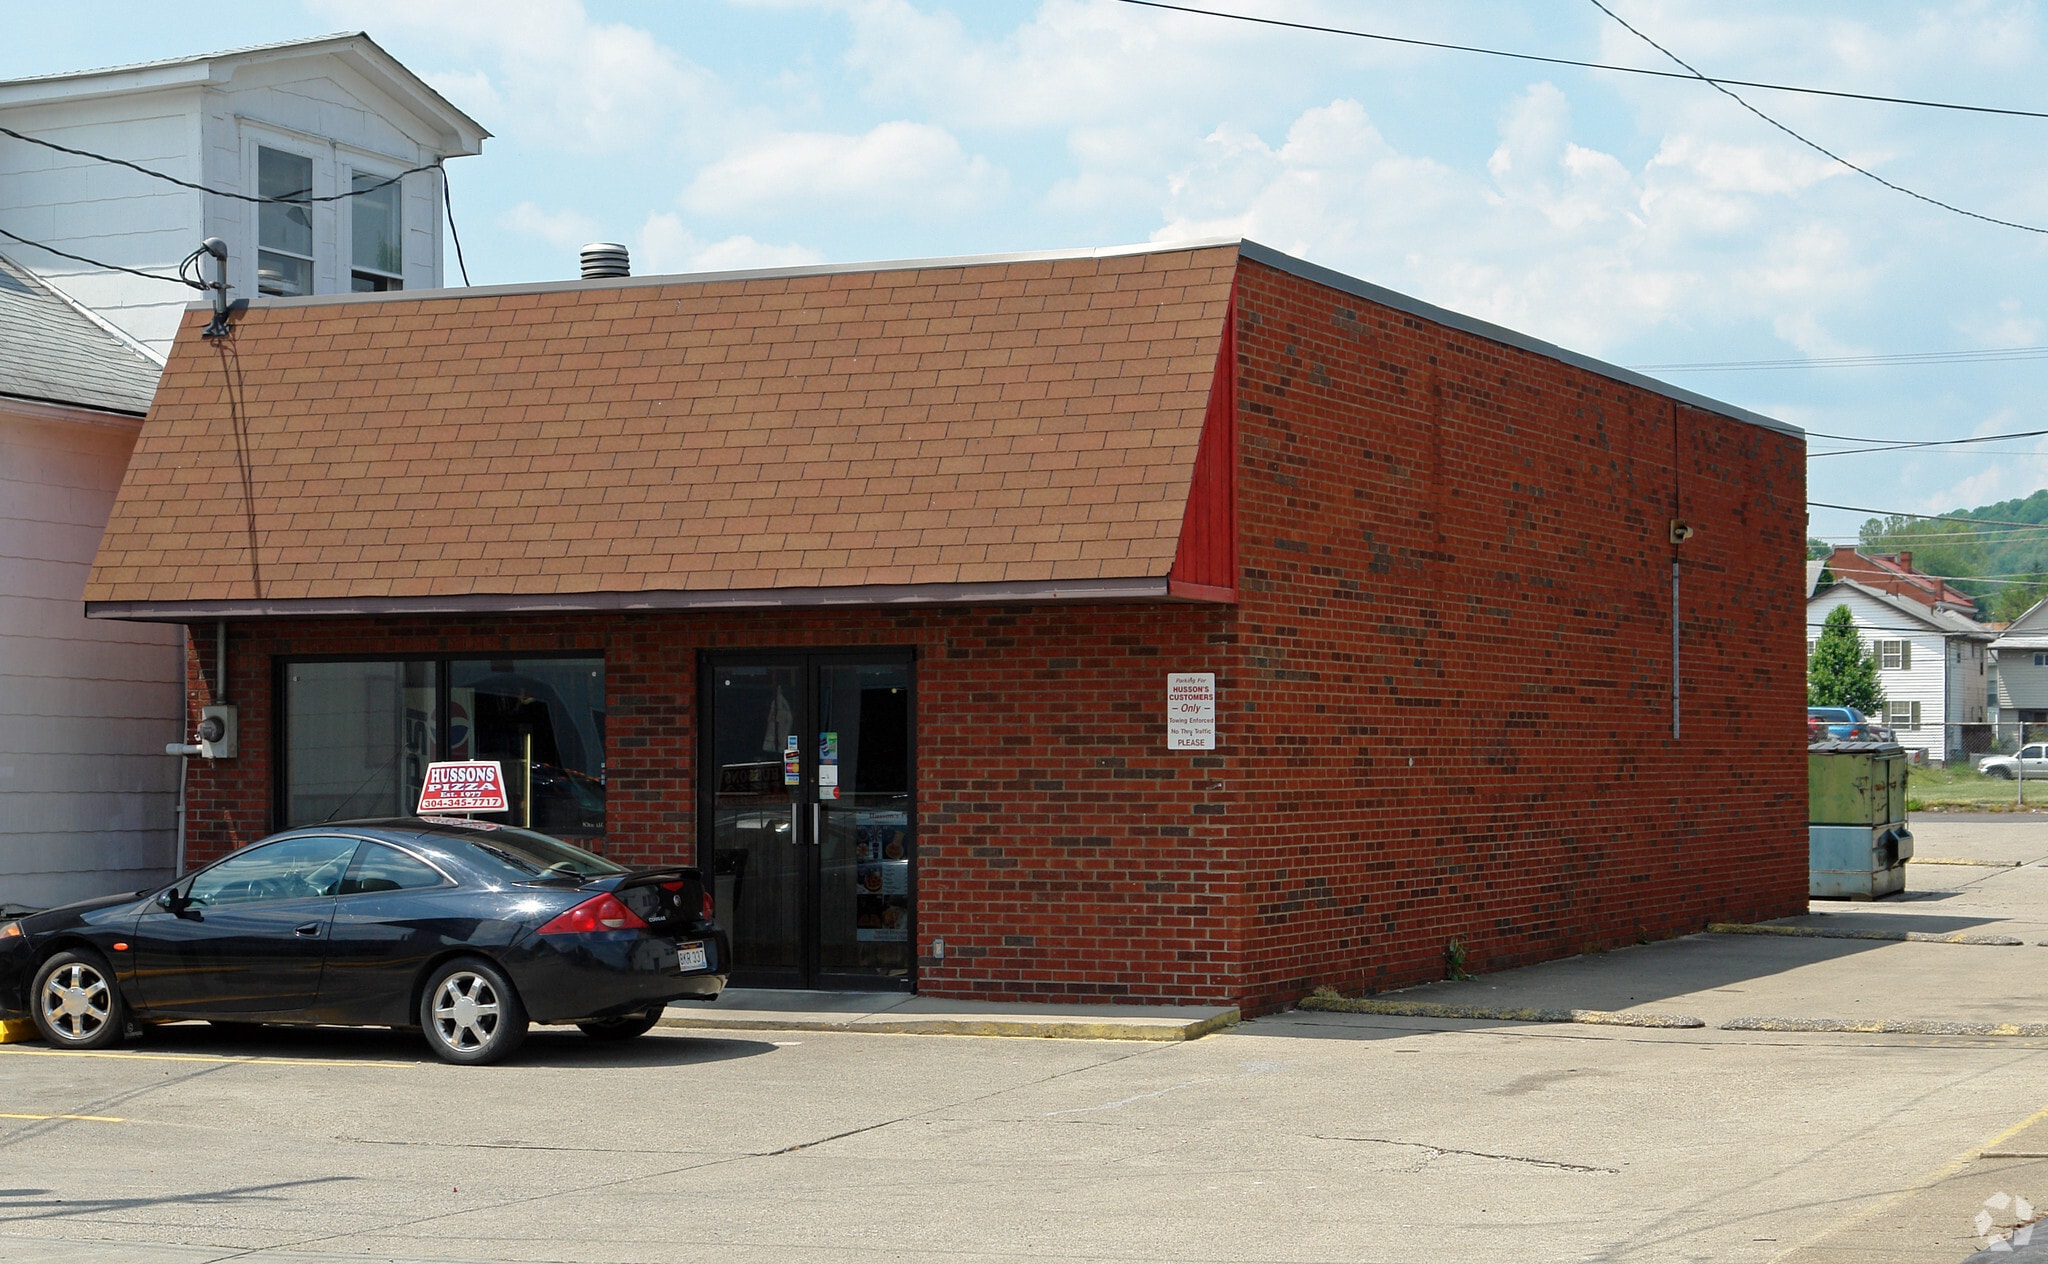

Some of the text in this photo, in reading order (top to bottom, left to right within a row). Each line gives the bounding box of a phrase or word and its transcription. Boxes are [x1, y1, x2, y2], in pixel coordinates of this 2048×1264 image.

[1181, 703, 1201, 714] Only
[431, 768, 494, 783] HUSSONS
[428, 783, 496, 792] PIZZA
[424, 798, 499, 808] 304-345-7717
